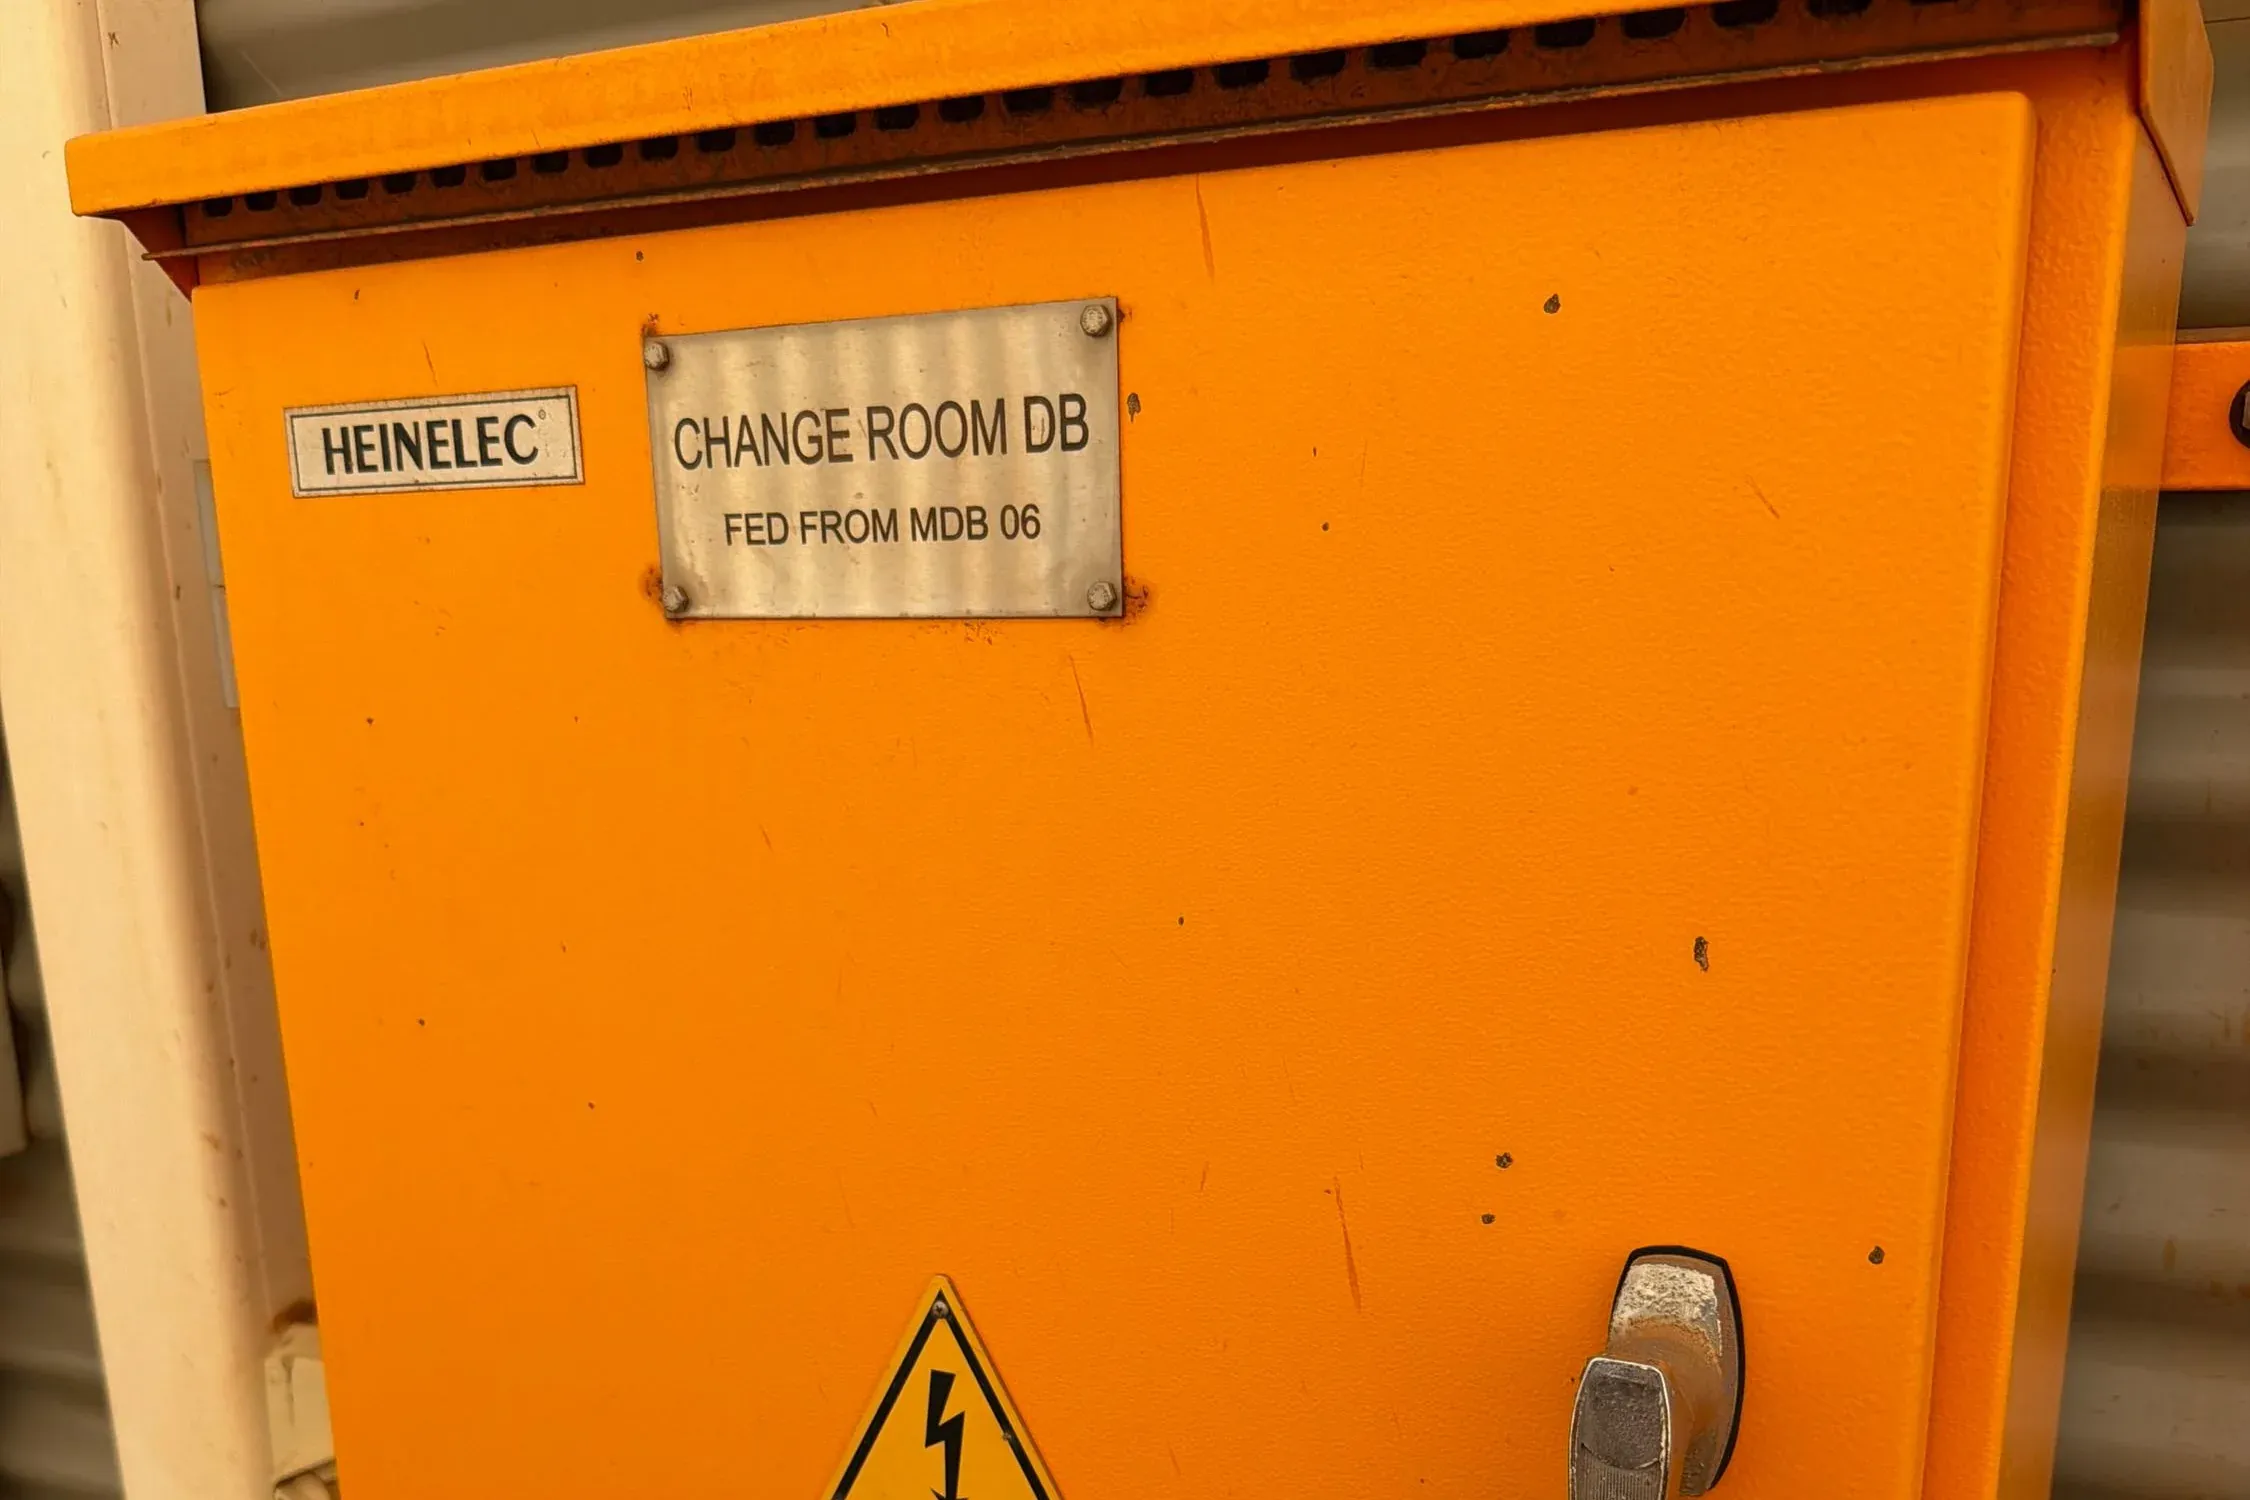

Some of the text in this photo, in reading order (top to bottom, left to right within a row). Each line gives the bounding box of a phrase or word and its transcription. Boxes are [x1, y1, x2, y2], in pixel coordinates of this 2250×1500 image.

[322, 413, 539, 475] HEINELEC
[674, 393, 1090, 470] CHANGE ROOM DB
[724, 503, 1041, 546] FED FROM MDB 06
